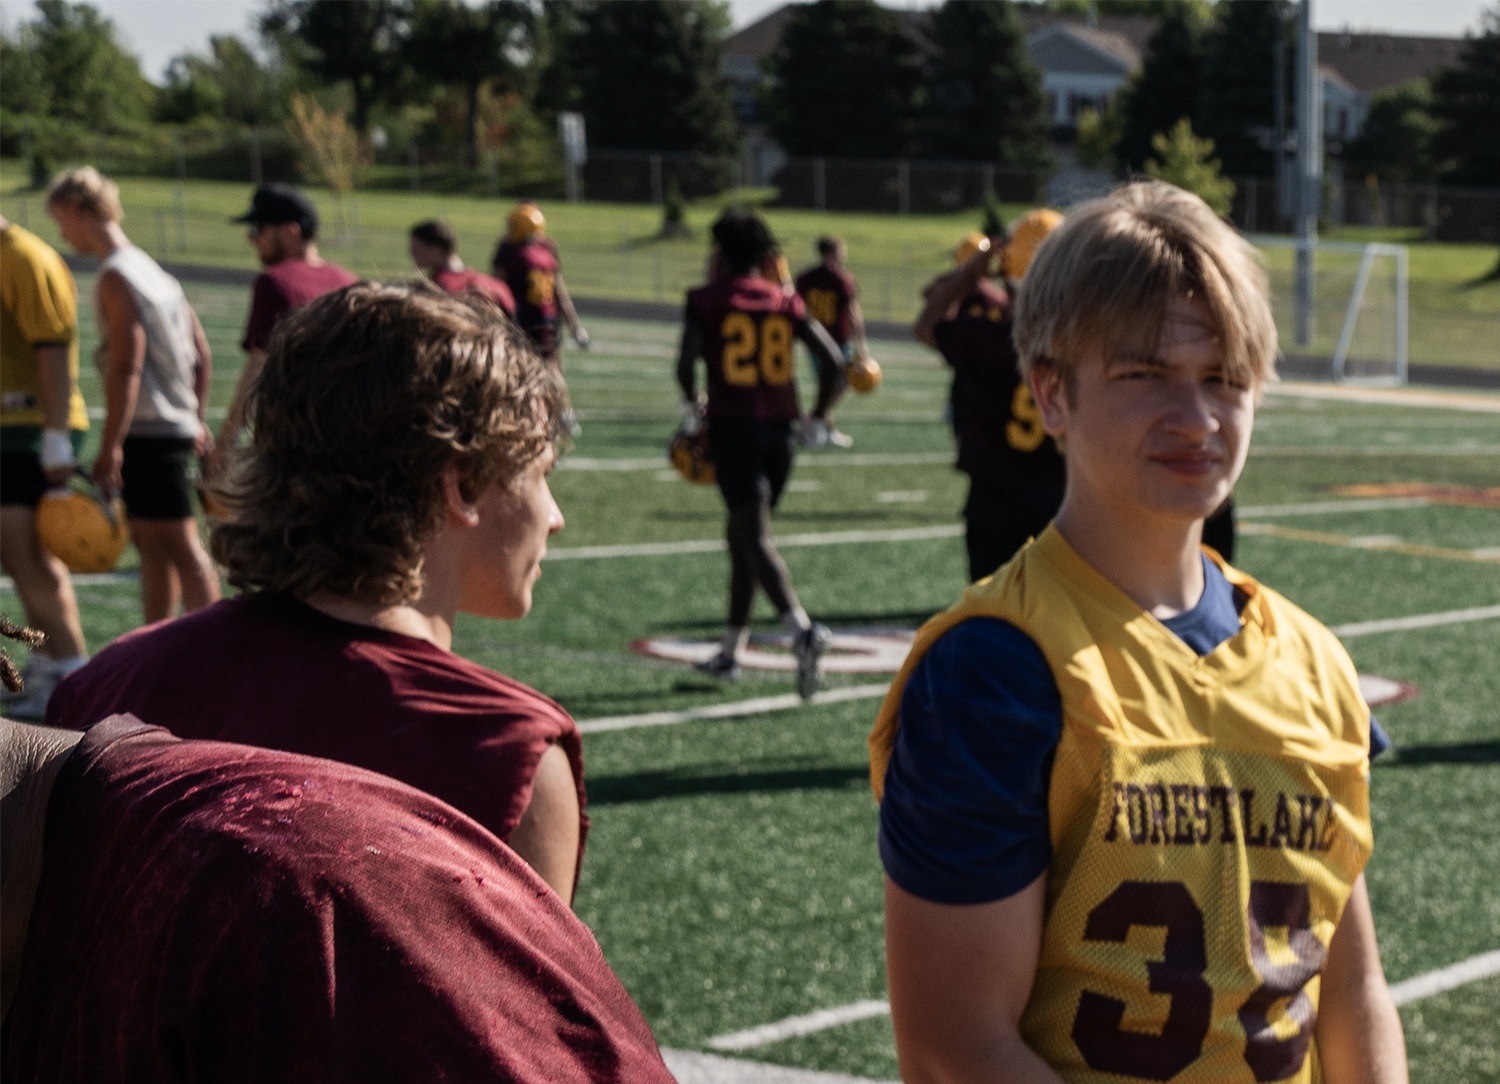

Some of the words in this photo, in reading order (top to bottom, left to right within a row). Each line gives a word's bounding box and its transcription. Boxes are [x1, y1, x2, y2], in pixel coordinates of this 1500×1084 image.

[721, 311, 793, 387] 28
[1104, 782, 1235, 846] FOREST
[1072, 880, 1328, 1084] 38
